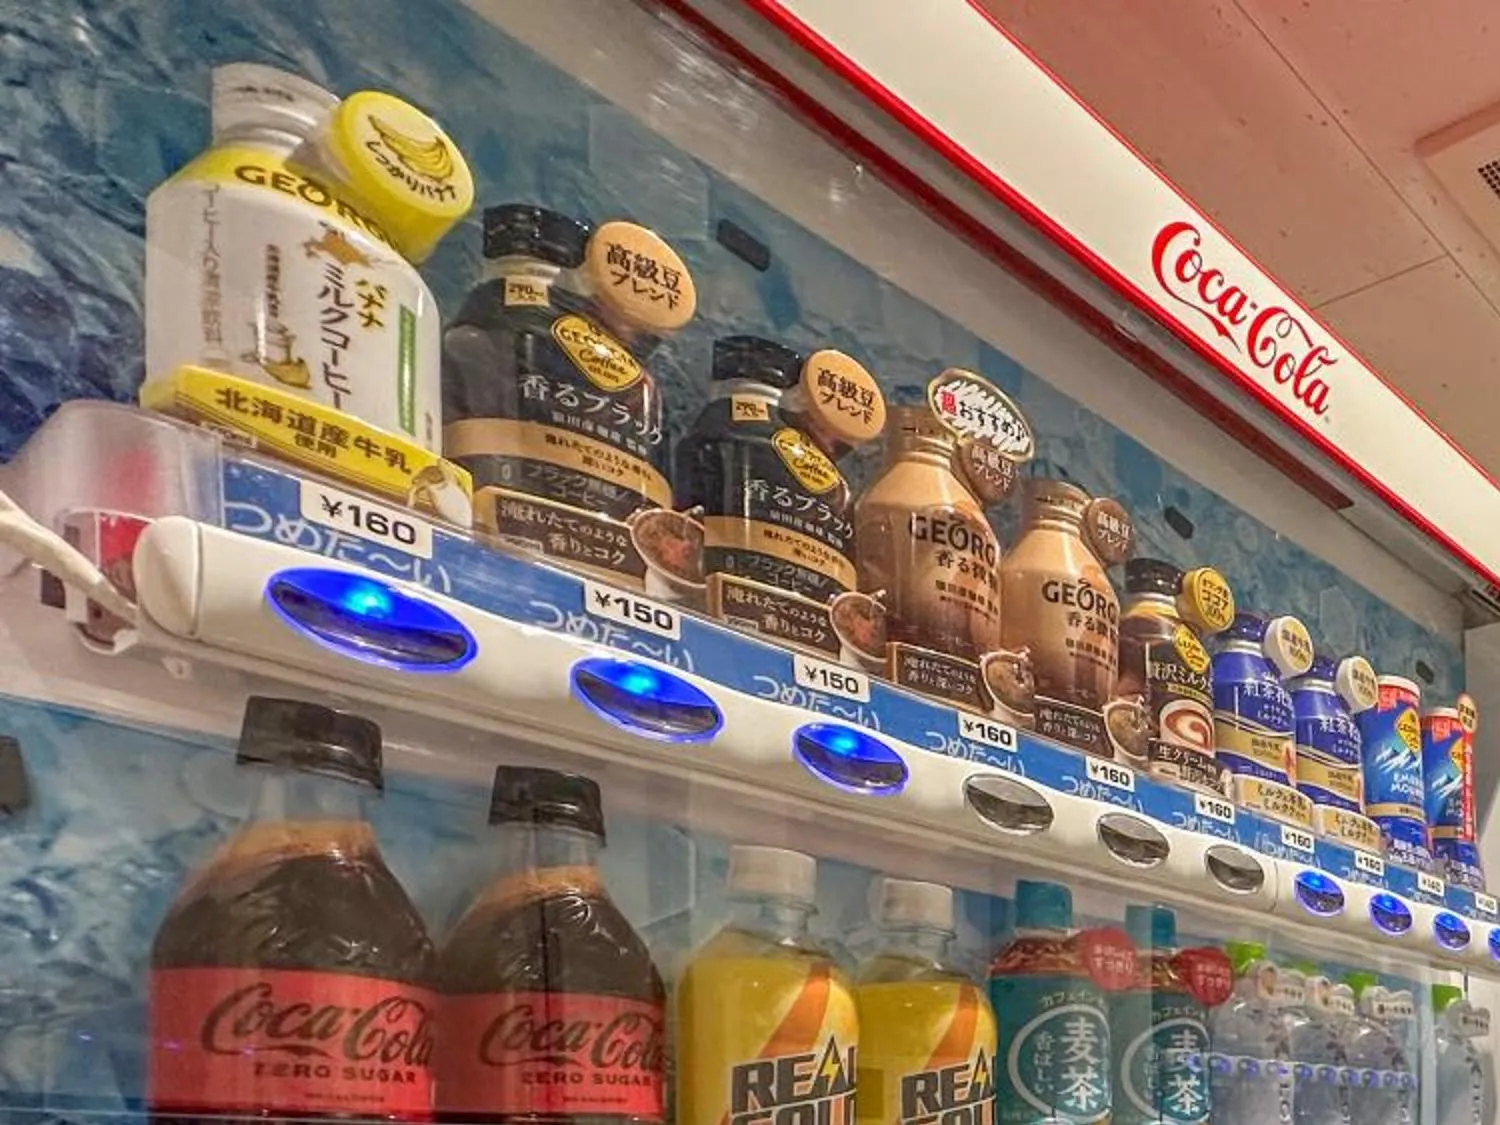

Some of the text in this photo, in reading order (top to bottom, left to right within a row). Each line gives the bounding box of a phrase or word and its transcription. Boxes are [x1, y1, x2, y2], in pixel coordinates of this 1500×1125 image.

[606, 243, 682, 293] 高級豆
[610, 269, 682, 310] ブレンド
[1151, 221, 1338, 415] Coca-Cola
[816, 366, 875, 410] 高級豆
[821, 391, 874, 425] ブレンド
[215, 386, 413, 475] 北海道産牛乳
[519, 374, 664, 446] 香るブラック
[293, 433, 339, 460] 使用
[320, 494, 418, 545] ¥160
[594, 590, 676, 632] ¥150
[805, 665, 860, 695] ¥150
[963, 718, 1013, 747] ¥160
[1089, 764, 1132, 787] ¥160
[1199, 798, 1232, 820] ¥160
[201, 982, 433, 1067] Coca-Cola
[478, 1004, 668, 1071] Coca-Cola
[253, 1063, 418, 1086] ZERO SUGAR
[521, 1070, 654, 1088] ZERO SUGAR
[1056, 1016, 1102, 1112] 麦茶
[1167, 1029, 1203, 1116] 麦茶
